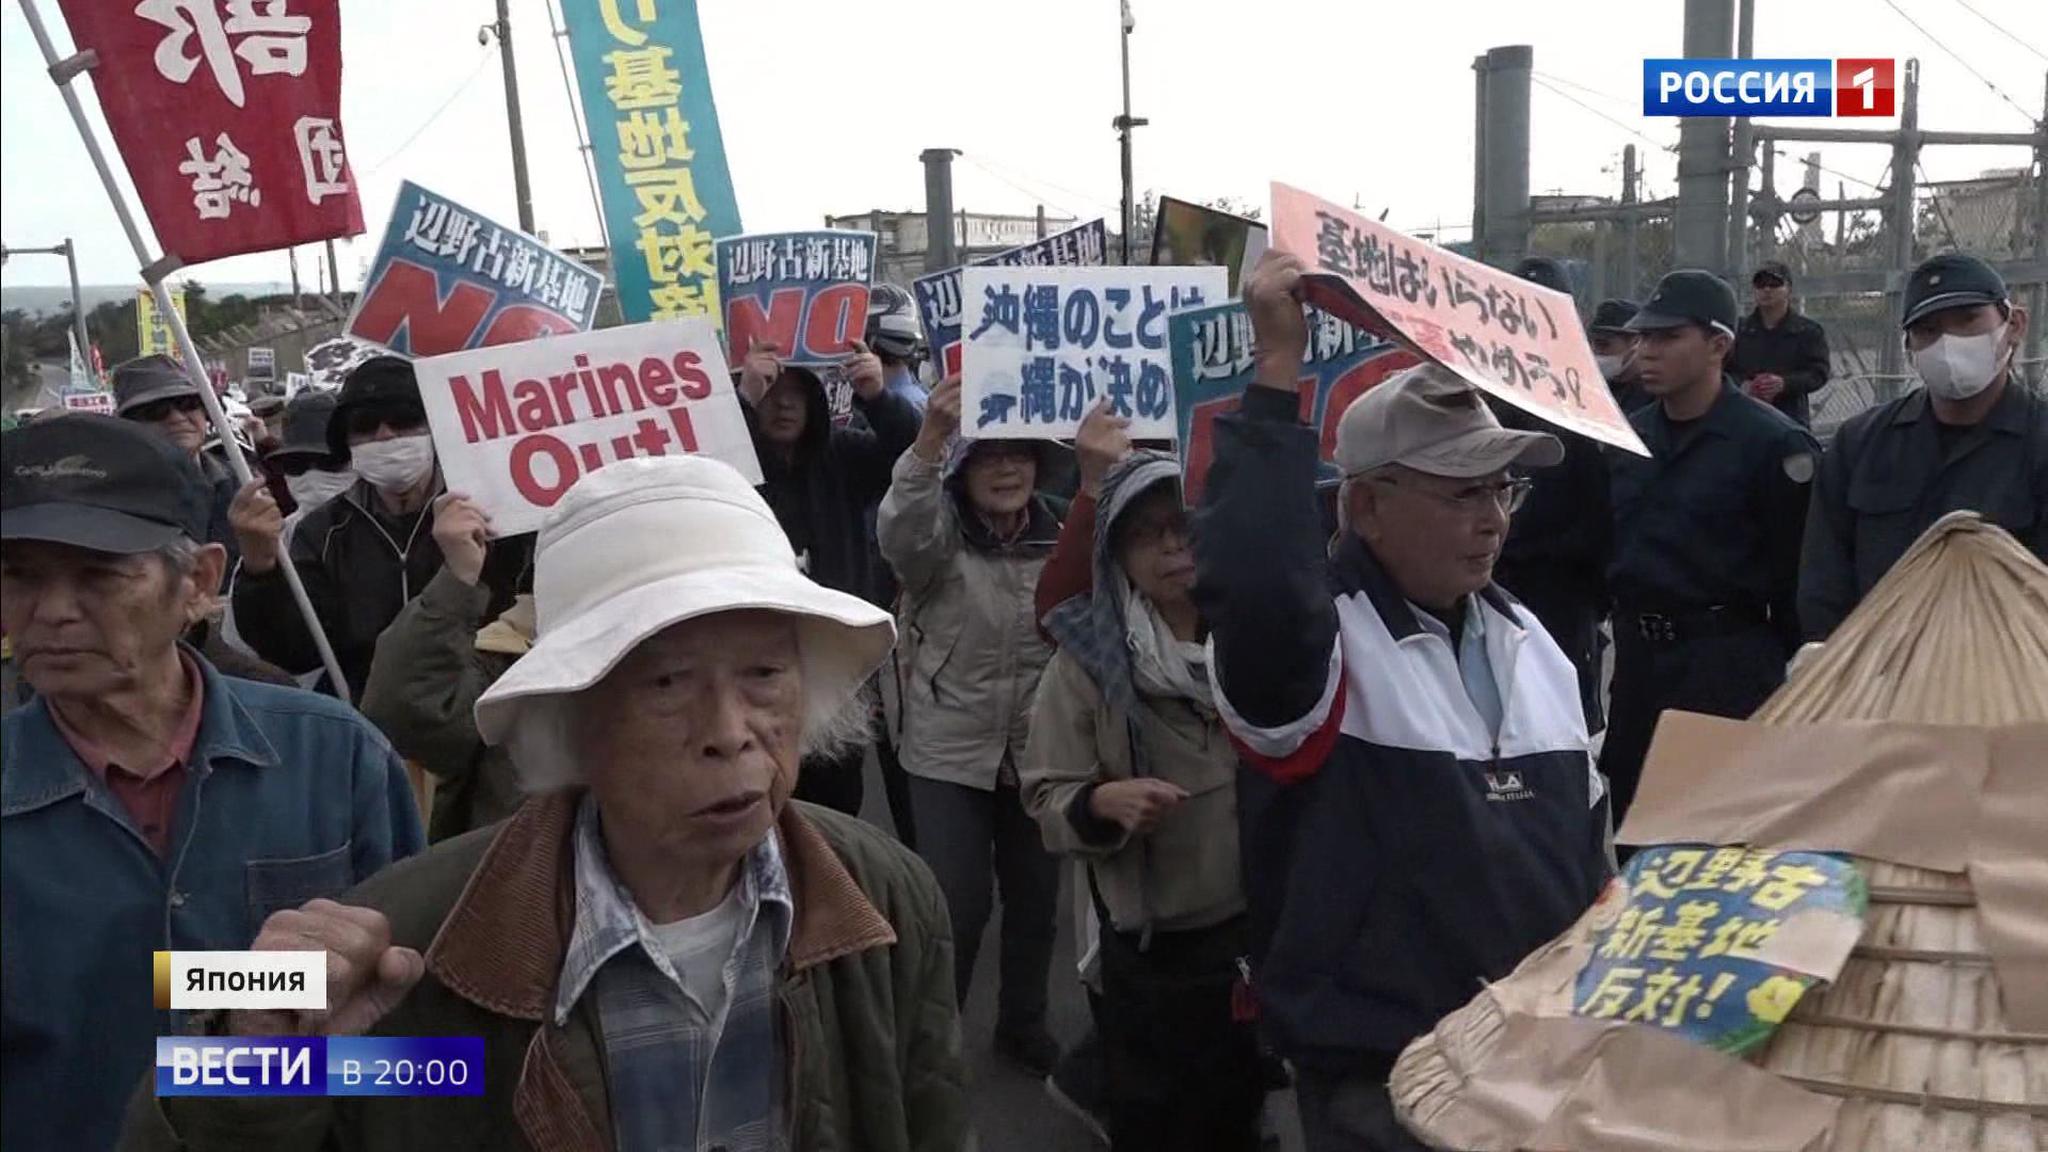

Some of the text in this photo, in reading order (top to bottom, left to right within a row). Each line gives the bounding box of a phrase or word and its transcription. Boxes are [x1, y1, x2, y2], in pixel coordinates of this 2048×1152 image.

[404, 194, 590, 323] 辺野古新基地
[728, 236, 868, 285] 辺野古新基地
[726, 283, 870, 372] NO
[448, 351, 712, 444] Marines
[1632, 848, 1828, 911] 辺野古
[1599, 900, 1780, 960] 新基地
